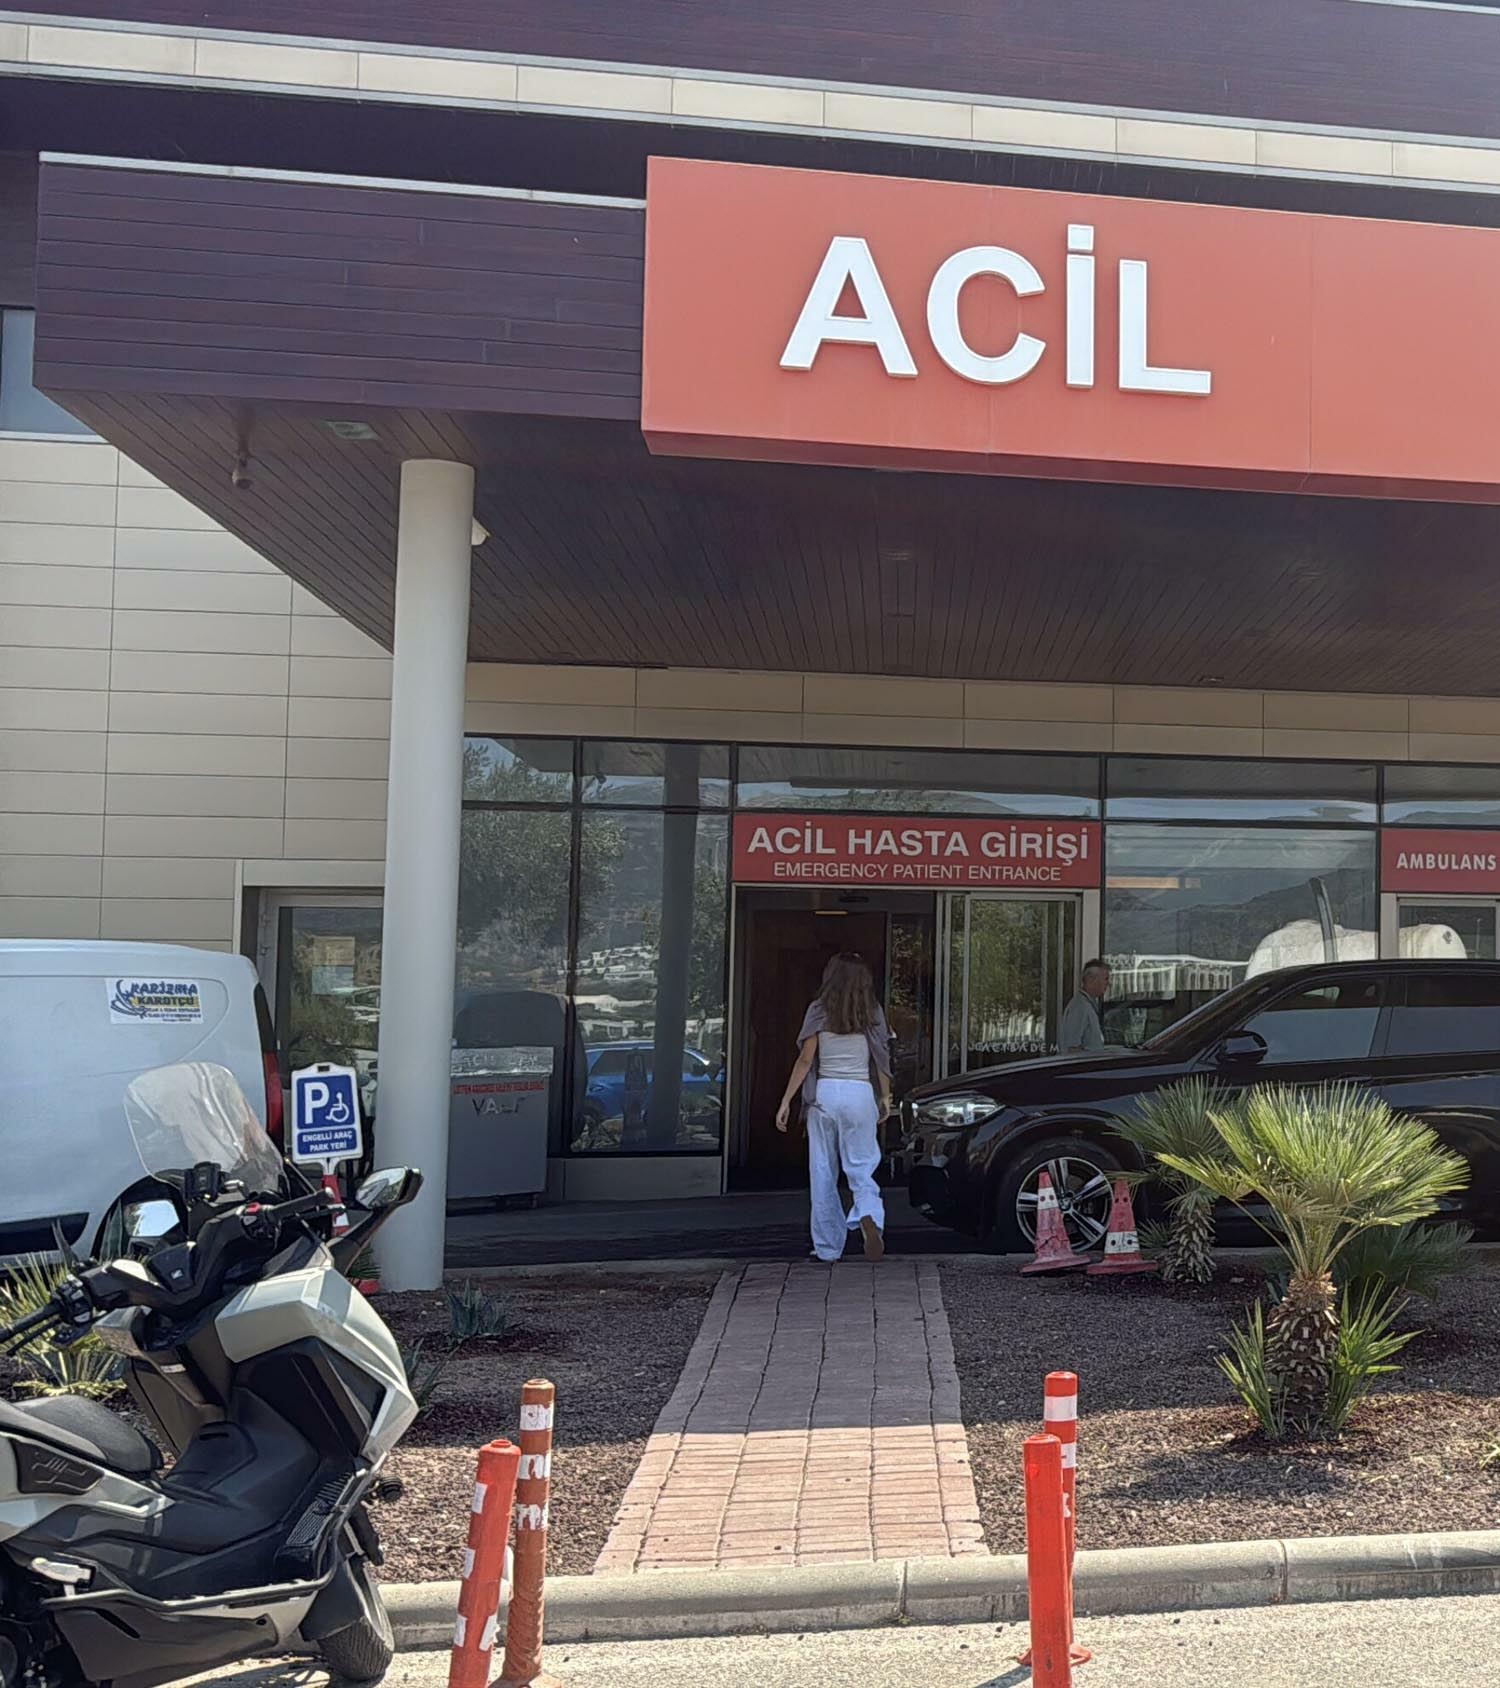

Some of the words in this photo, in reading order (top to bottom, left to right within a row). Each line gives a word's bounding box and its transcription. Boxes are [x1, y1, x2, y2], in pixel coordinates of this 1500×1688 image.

[780, 223, 1212, 397] ACİL
[747, 820, 836, 855] ACİL
[849, 828, 970, 857] HASTA
[980, 825, 1088, 866] GİRİŞİ
[774, 861, 890, 879] EMERGENCY
[893, 863, 964, 880] PATIENT
[968, 865, 1061, 881] ENTRANCE
[1397, 852, 1497, 872] AMBULANS
[304, 1082, 330, 1124] P
[302, 1131, 332, 1142] ENGELLİ
[333, 1130, 353, 1140] ARAÇ
[309, 1143, 329, 1152] PARK
[330, 1141, 347, 1150] YERİ
